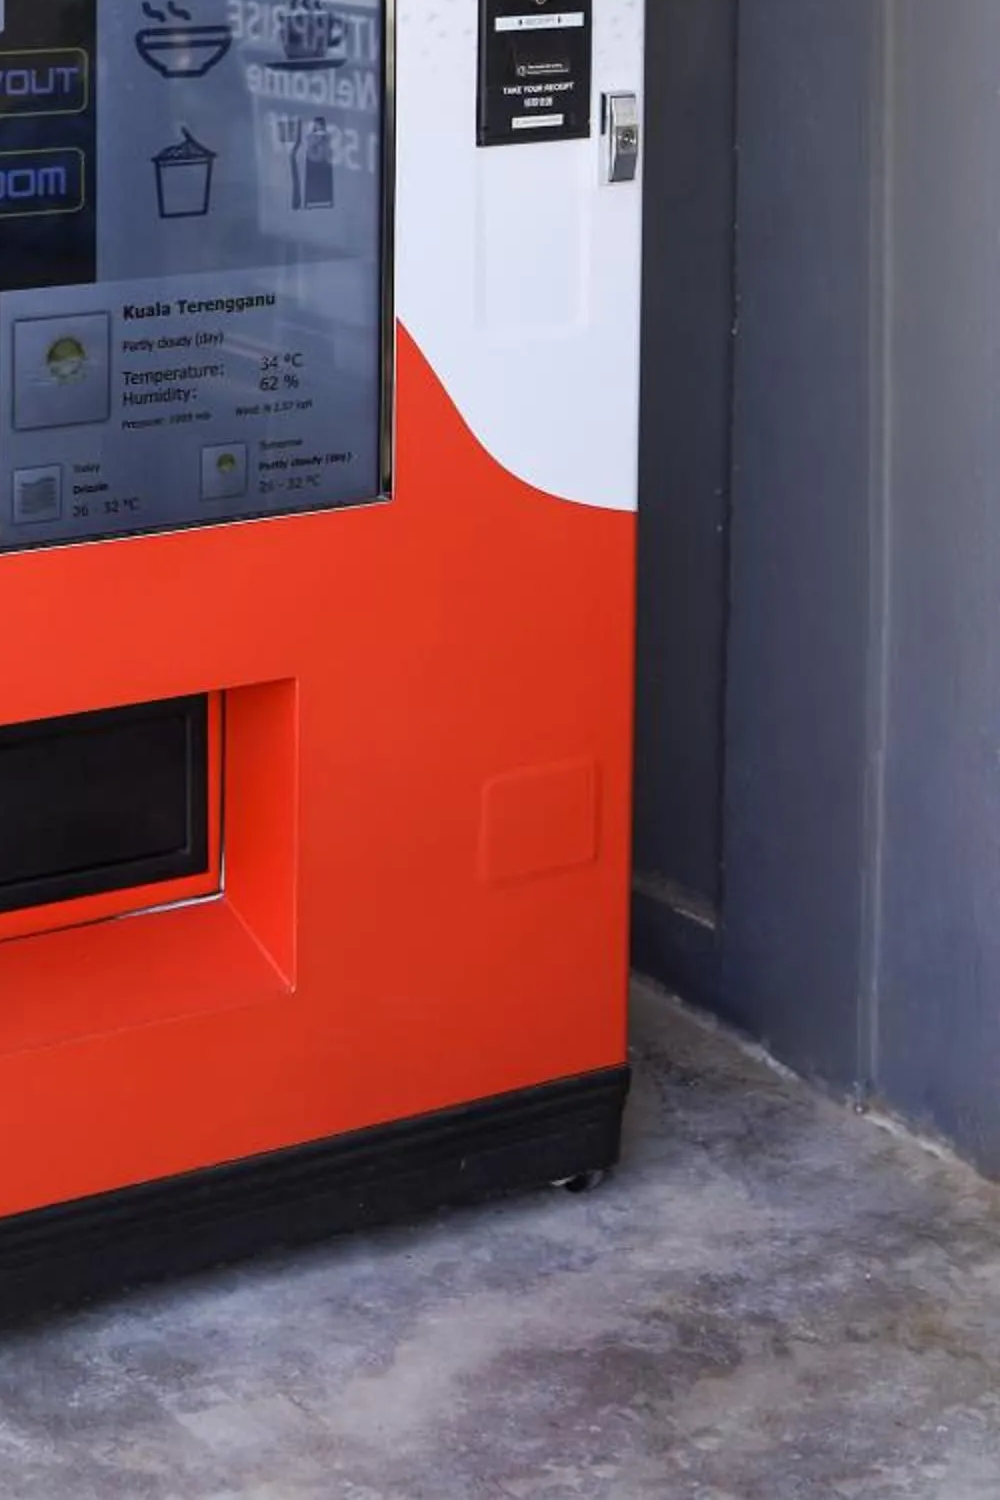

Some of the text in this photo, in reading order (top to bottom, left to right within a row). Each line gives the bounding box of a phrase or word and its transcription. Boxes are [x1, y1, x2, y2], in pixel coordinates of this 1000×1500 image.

[122, 292, 277, 321] Kuala Terengganu
[122, 363, 225, 387] Temperature:
[122, 387, 198, 406] Humidity:
[259, 376, 279, 392] 62
